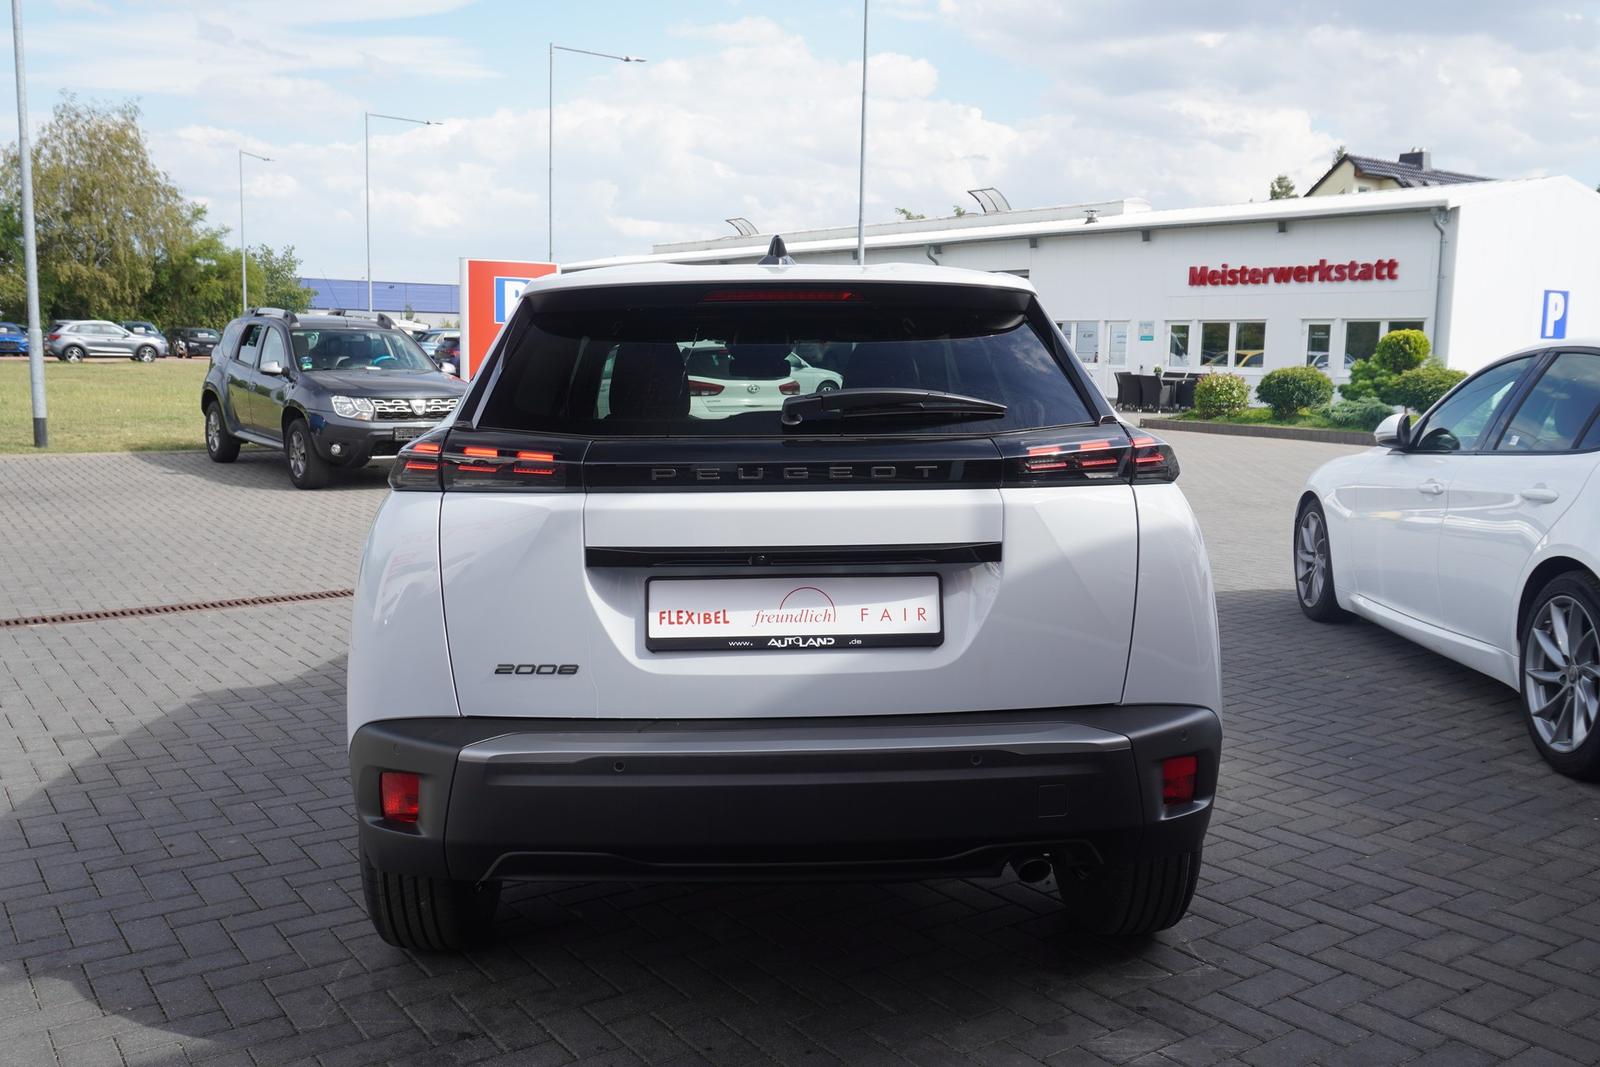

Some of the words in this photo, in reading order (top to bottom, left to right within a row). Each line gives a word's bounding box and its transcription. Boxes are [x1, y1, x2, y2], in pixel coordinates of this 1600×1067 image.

[1188, 259, 1399, 287] Meisterwerkstatt
[1545, 292, 1565, 337] P
[651, 465, 938, 481] PEUGEOT
[752, 606, 833, 628] freundlich
[494, 663, 580, 675] 2008
